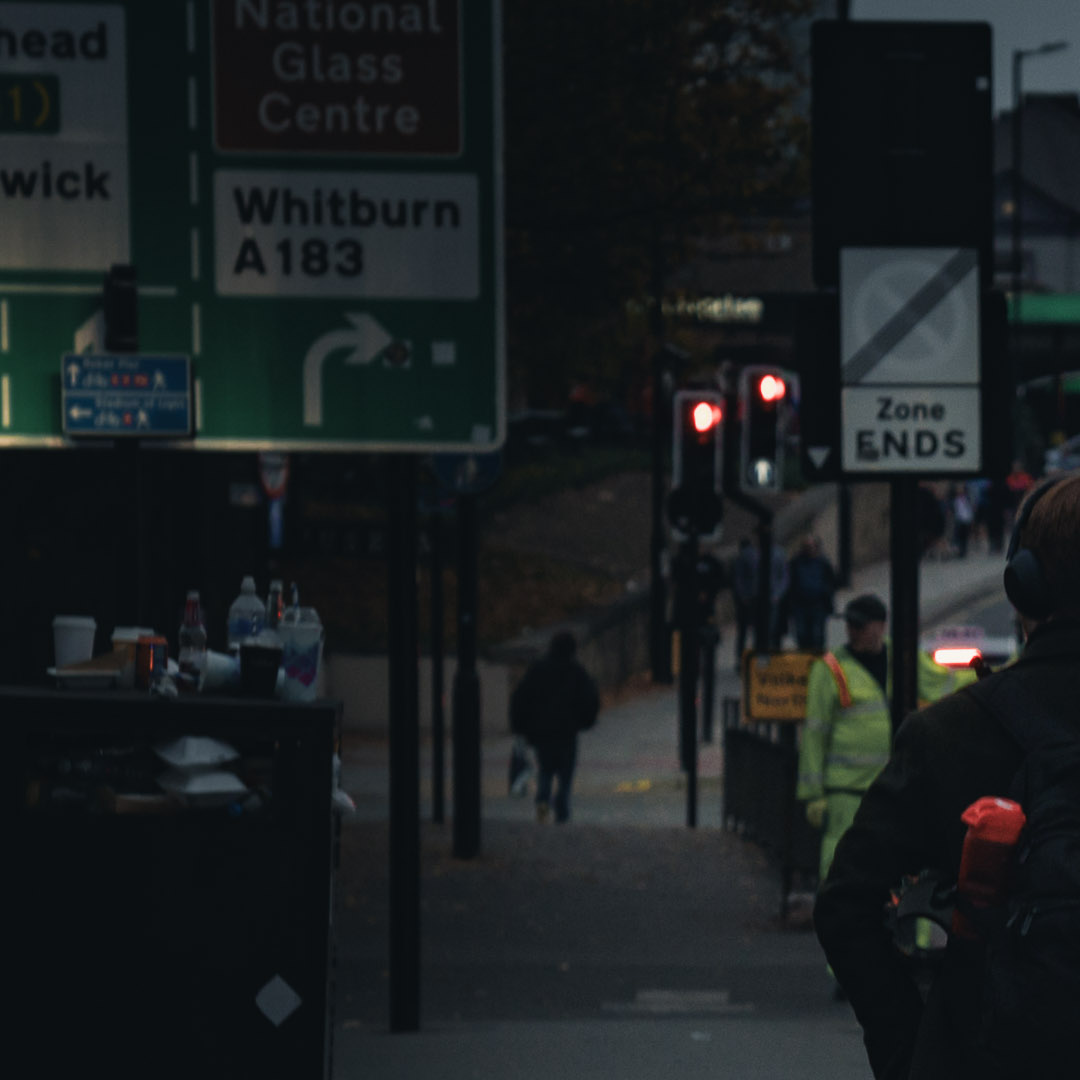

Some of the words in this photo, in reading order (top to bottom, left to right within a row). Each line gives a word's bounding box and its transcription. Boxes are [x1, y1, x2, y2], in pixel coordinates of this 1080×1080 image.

[234, 0, 442, 33] National
[272, 41, 405, 84] Glass
[257, 91, 421, 134] Centre
[233, 187, 461, 229] Whitburn
[233, 237, 365, 278] A183
[877, 396, 946, 421] Zone
[857, 430, 966, 460] ENDS
